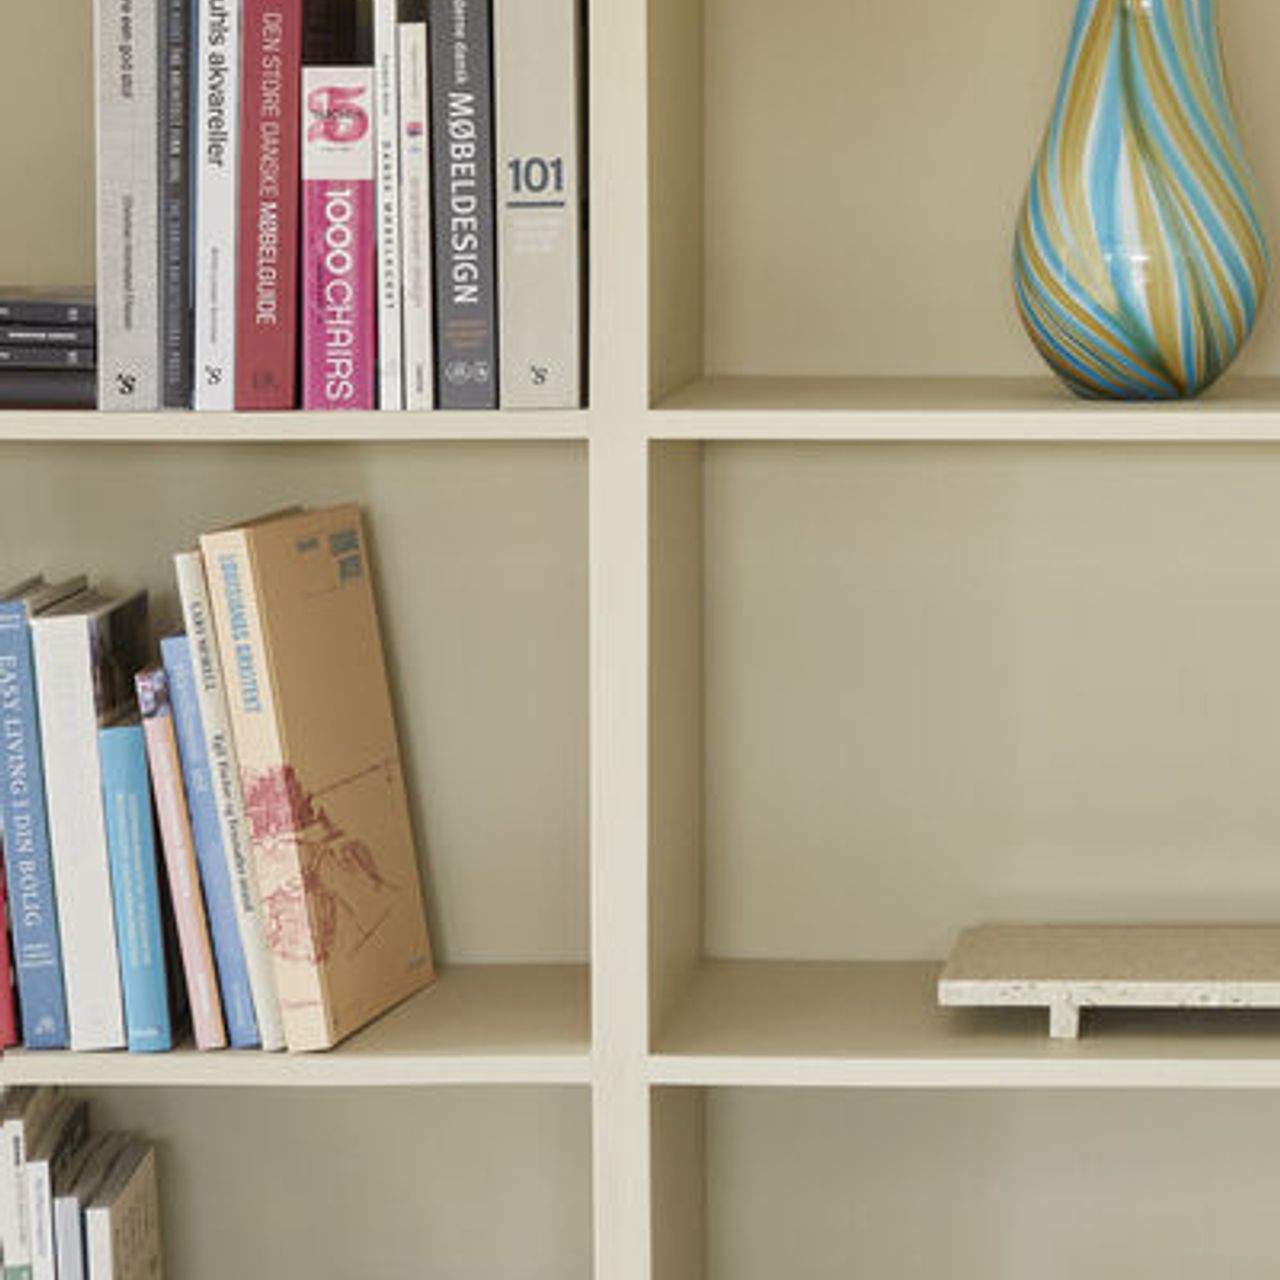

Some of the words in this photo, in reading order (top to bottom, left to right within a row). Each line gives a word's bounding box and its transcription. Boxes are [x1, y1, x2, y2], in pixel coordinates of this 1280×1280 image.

[261, 12, 283, 53] DEN
[207, 51, 230, 168] akvareller
[260, 54, 282, 117] STORE
[257, 121, 281, 198] DANSKE
[448, 91, 479, 304] MØBELDESIGN
[508, 156, 564, 193] 101
[255, 201, 278, 325] MØBELGUIDE
[324, 188, 353, 275] 1000
[324, 278, 353, 402] CHAIRS
[1, 656, 21, 712] EASY
[4, 717, 28, 795] LIVING
[13, 814, 35, 853] DIN
[16, 858, 44, 927] BOLIG
